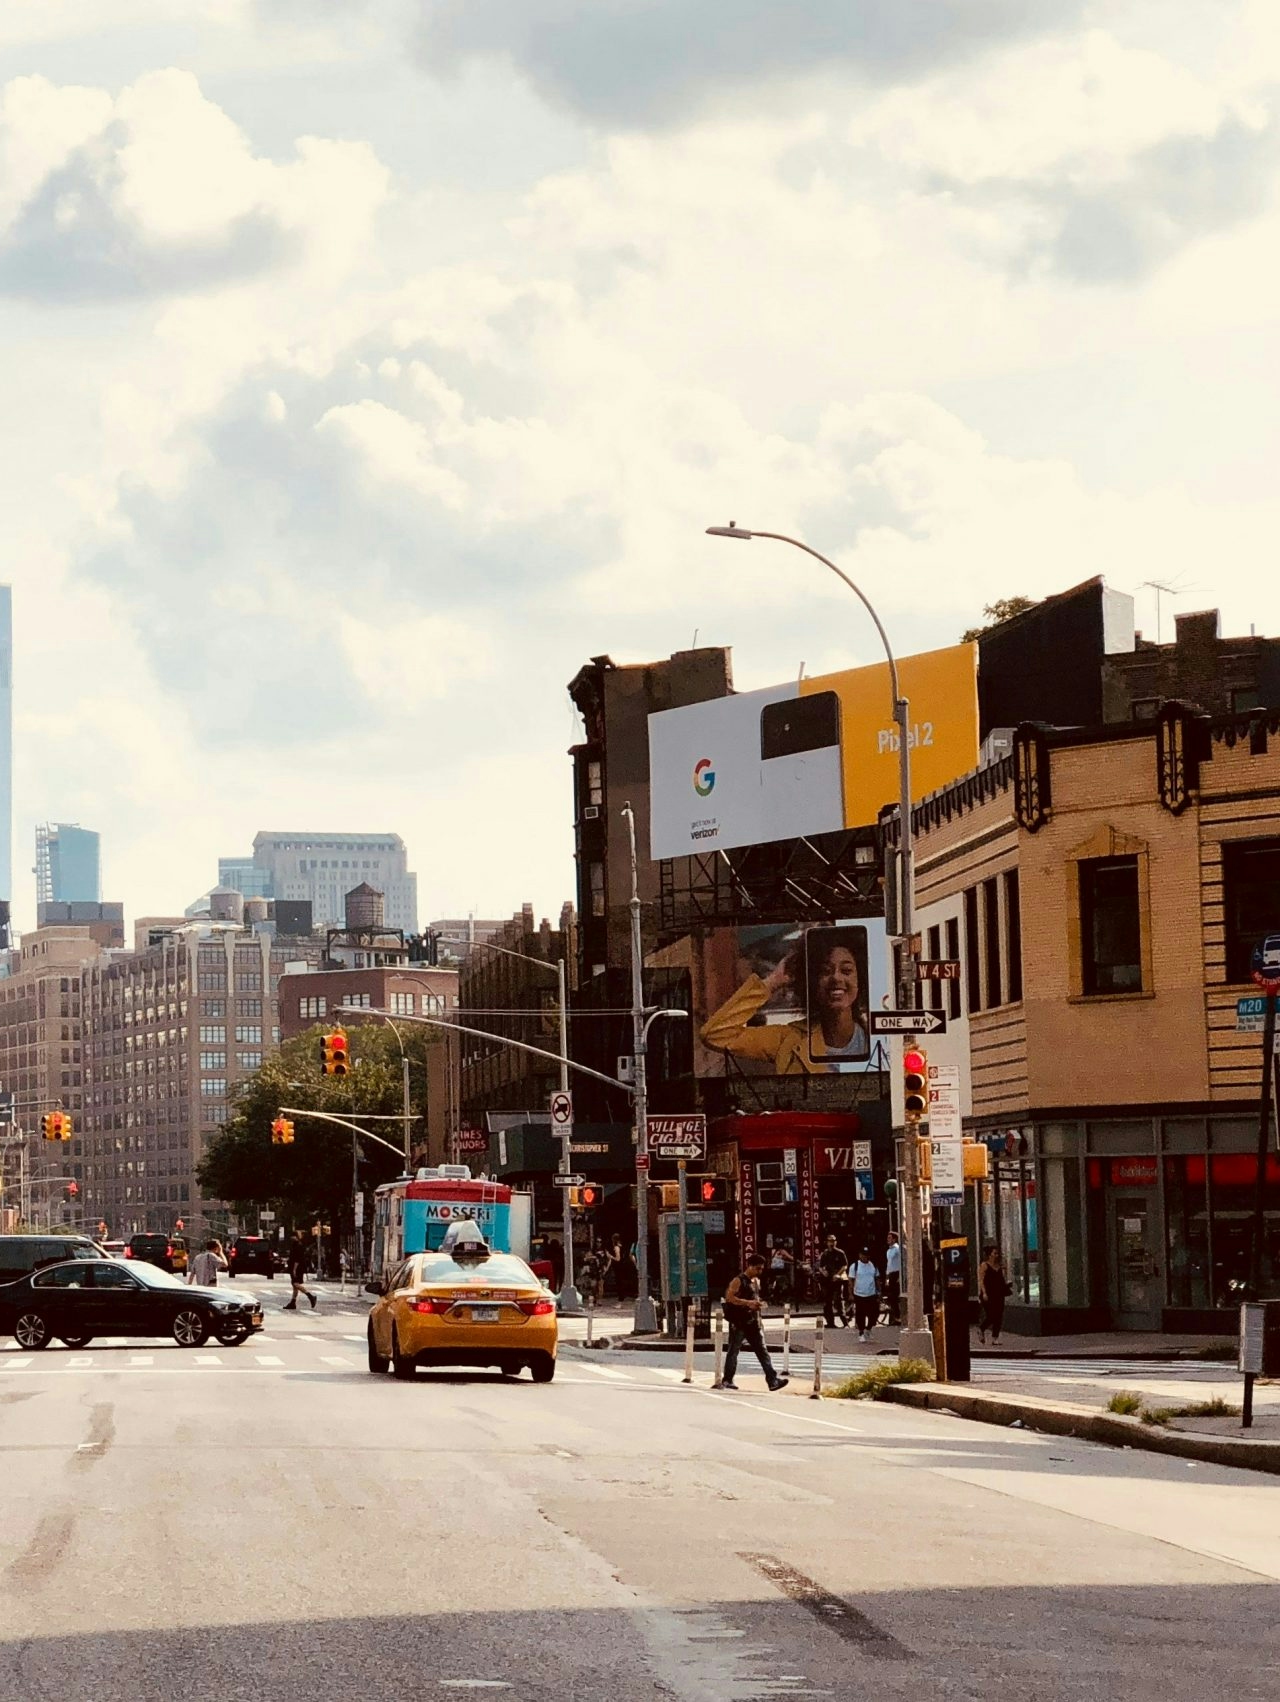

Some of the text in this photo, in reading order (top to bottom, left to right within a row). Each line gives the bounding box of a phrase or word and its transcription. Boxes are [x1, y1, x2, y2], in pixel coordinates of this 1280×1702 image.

[922, 722, 933, 745] 2
[693, 758, 716, 797] G
[690, 827, 718, 840] verizon
[919, 963, 957, 979] W 4 ST
[1238, 999, 1262, 1012] M20
[880, 1017, 935, 1028] ONE WAY
[931, 1090, 938, 1101] 2
[571, 1144, 602, 1153] CHRISTOPHER
[933, 1143, 940, 1154] 2
[786, 1163, 795, 1172] 20
[856, 1156, 870, 1167] 20
[951, 1249, 960, 1262] P
